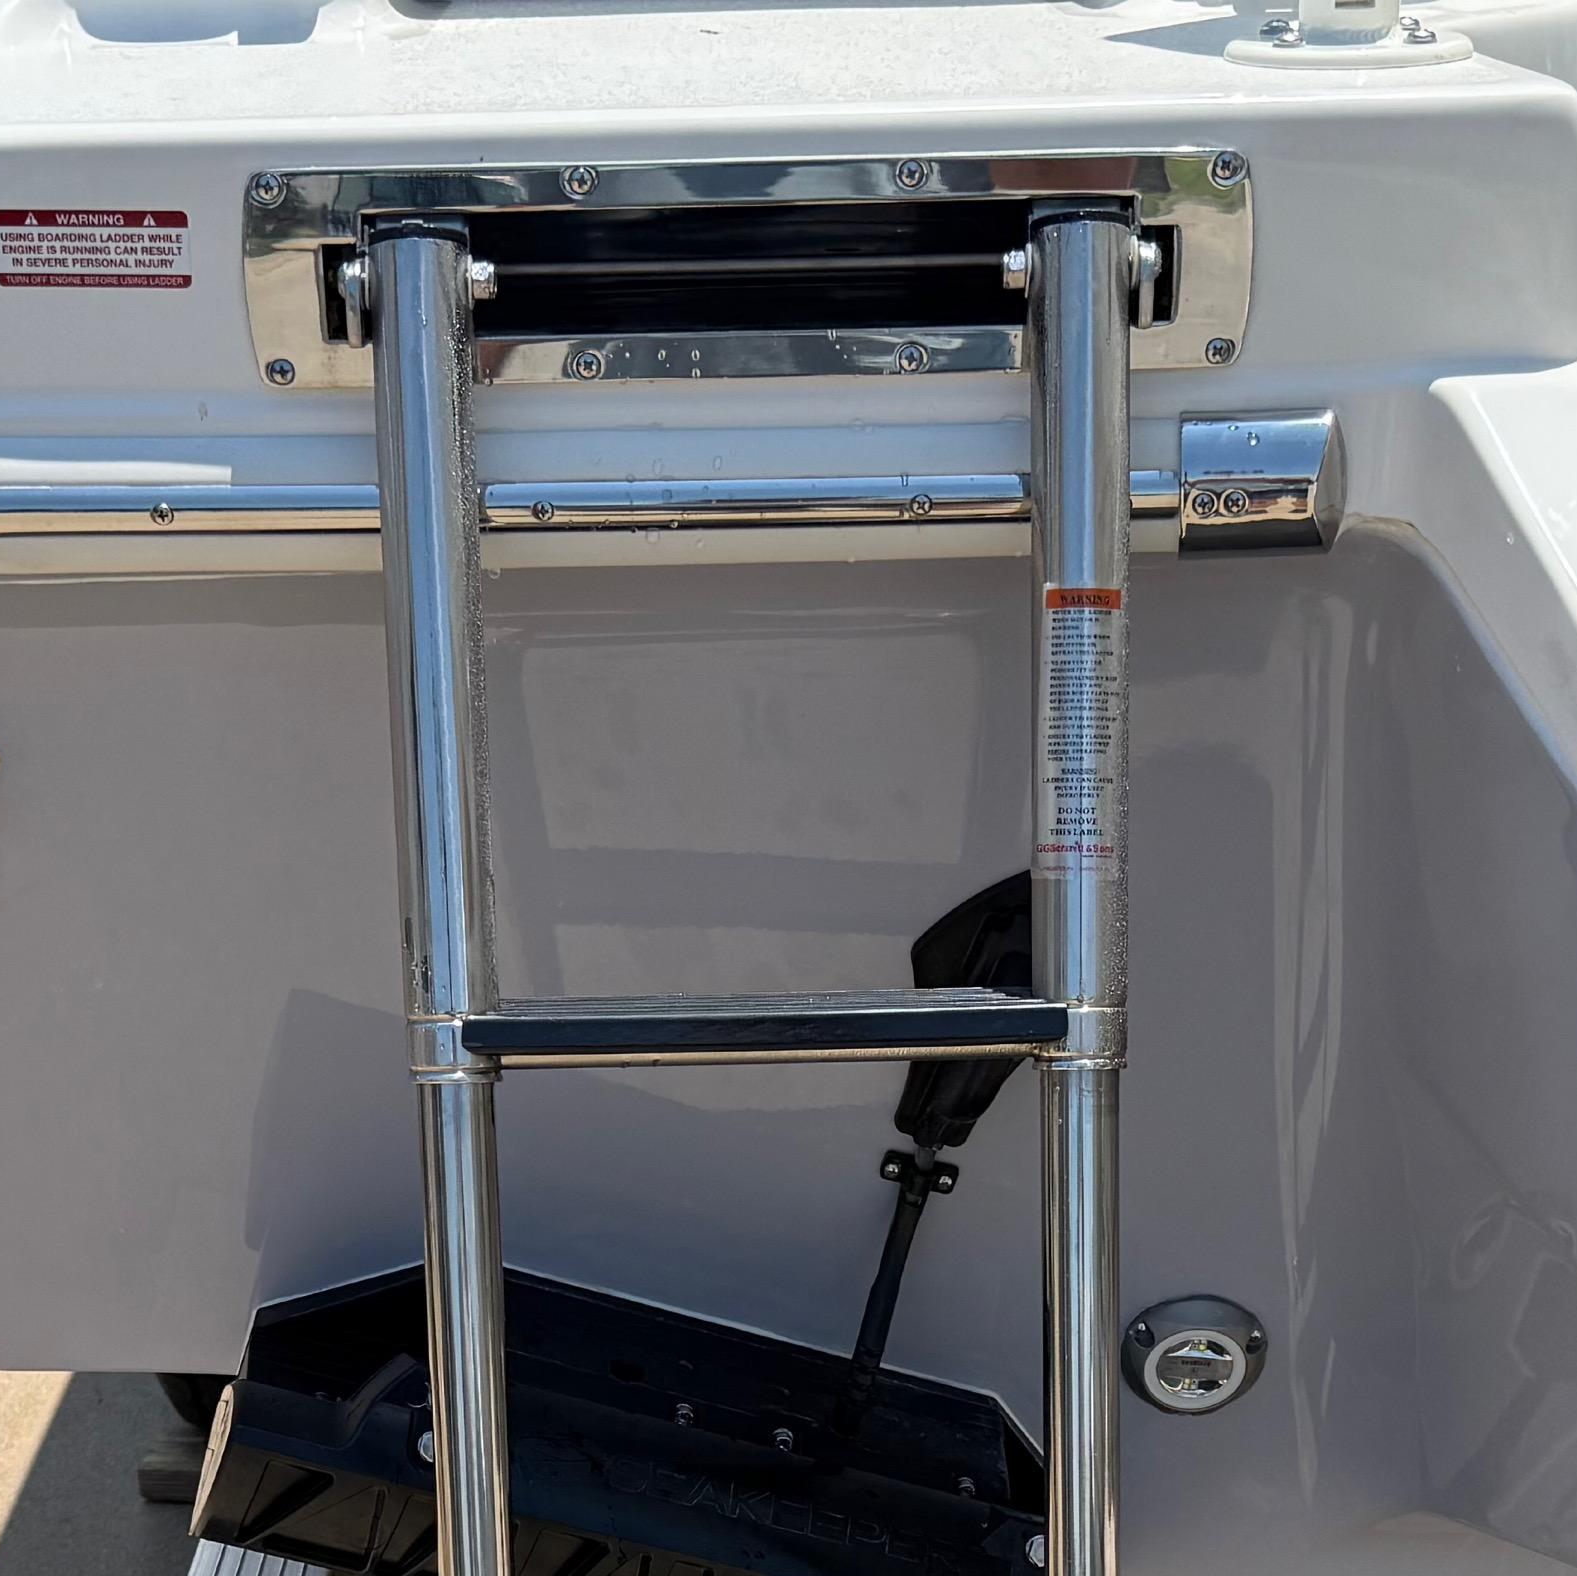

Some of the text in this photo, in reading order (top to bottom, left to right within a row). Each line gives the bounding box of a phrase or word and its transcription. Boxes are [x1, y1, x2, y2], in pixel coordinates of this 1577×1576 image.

[55, 212, 124, 226] WARNING
[0, 232, 183, 244] USING BOARDING LADDER WHILE
[2, 245, 183, 256] ENGINE IS RUNNING CAN RESULT
[12, 257, 174, 269] IN SEVERE PERSONAL INJURY
[6, 275, 184, 287] TURN OFF ENGINE BEFORE USING LADDER
[1059, 594, 1111, 606] WARNING
[1058, 807, 1097, 815] DO NOT
[1056, 817, 1099, 826] REMOVE
[1048, 828, 1105, 836] THIS LABEL
